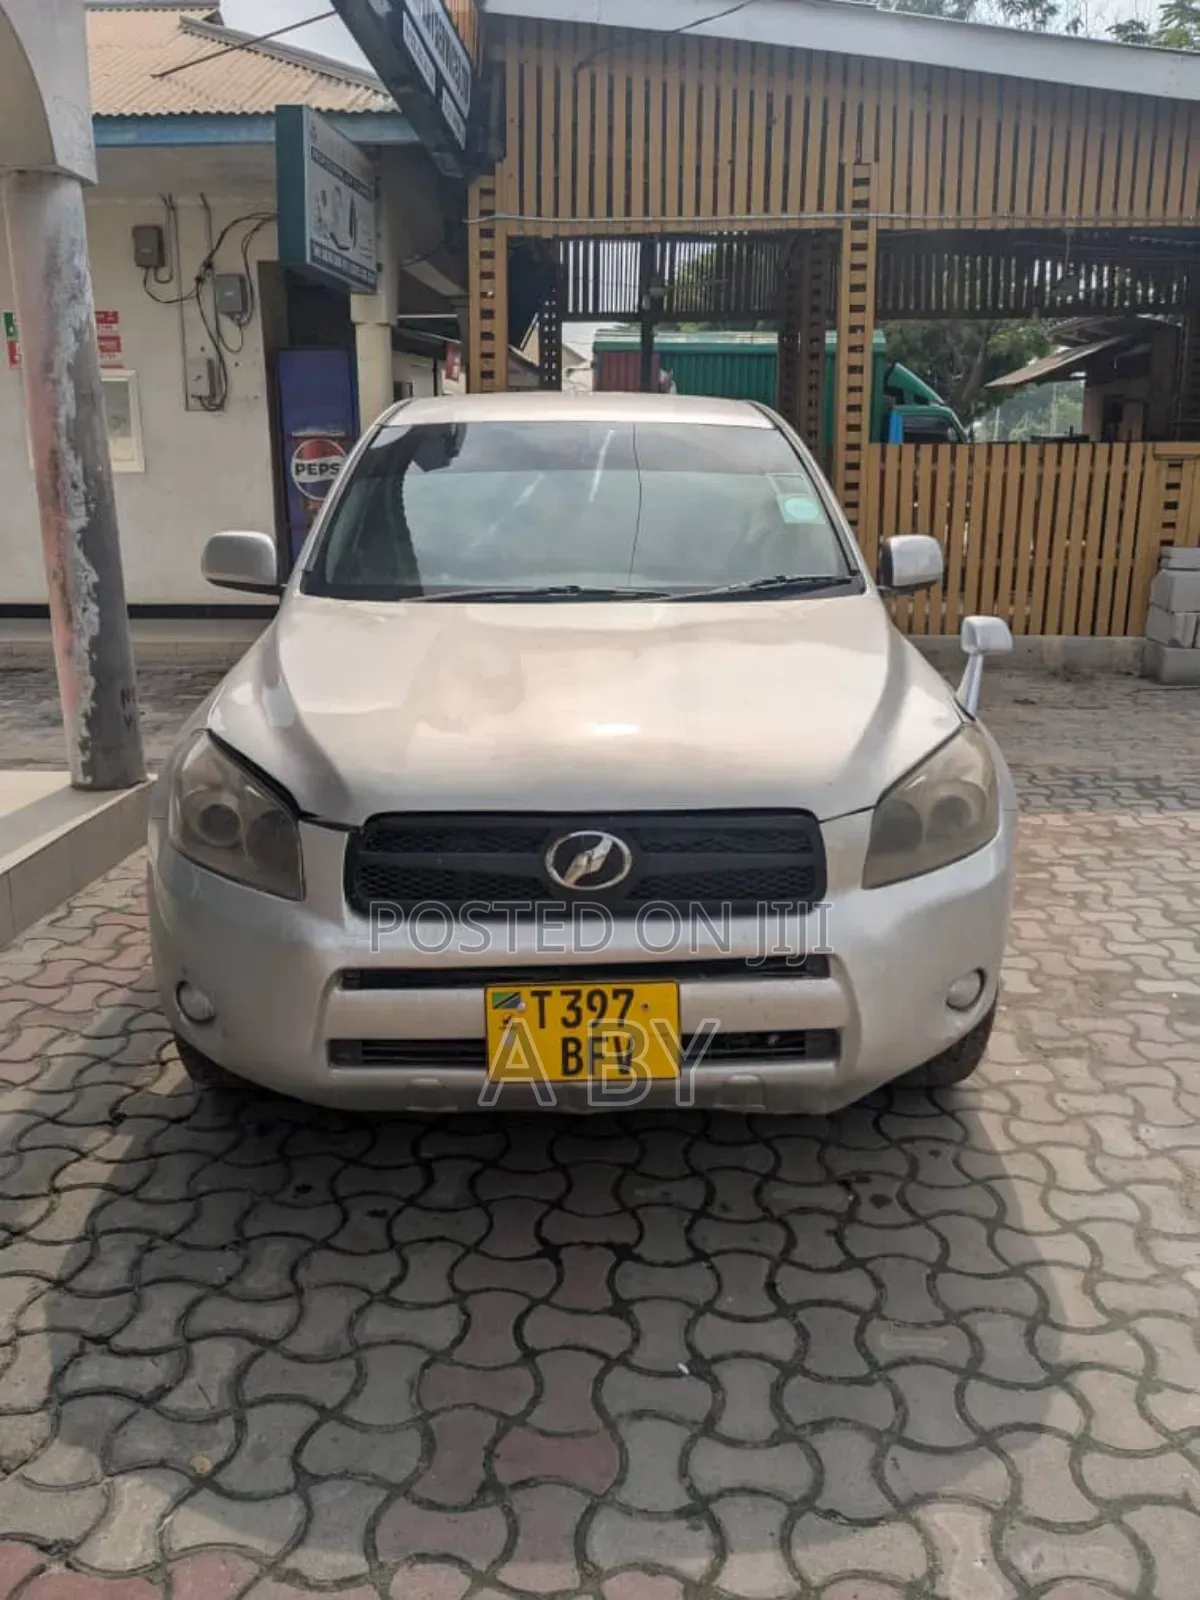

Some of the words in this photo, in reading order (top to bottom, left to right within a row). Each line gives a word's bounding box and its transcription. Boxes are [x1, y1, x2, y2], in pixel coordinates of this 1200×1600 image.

[295, 463, 341, 476] PEPS
[530, 989, 553, 1029] T
[560, 988, 635, 1029] 397
